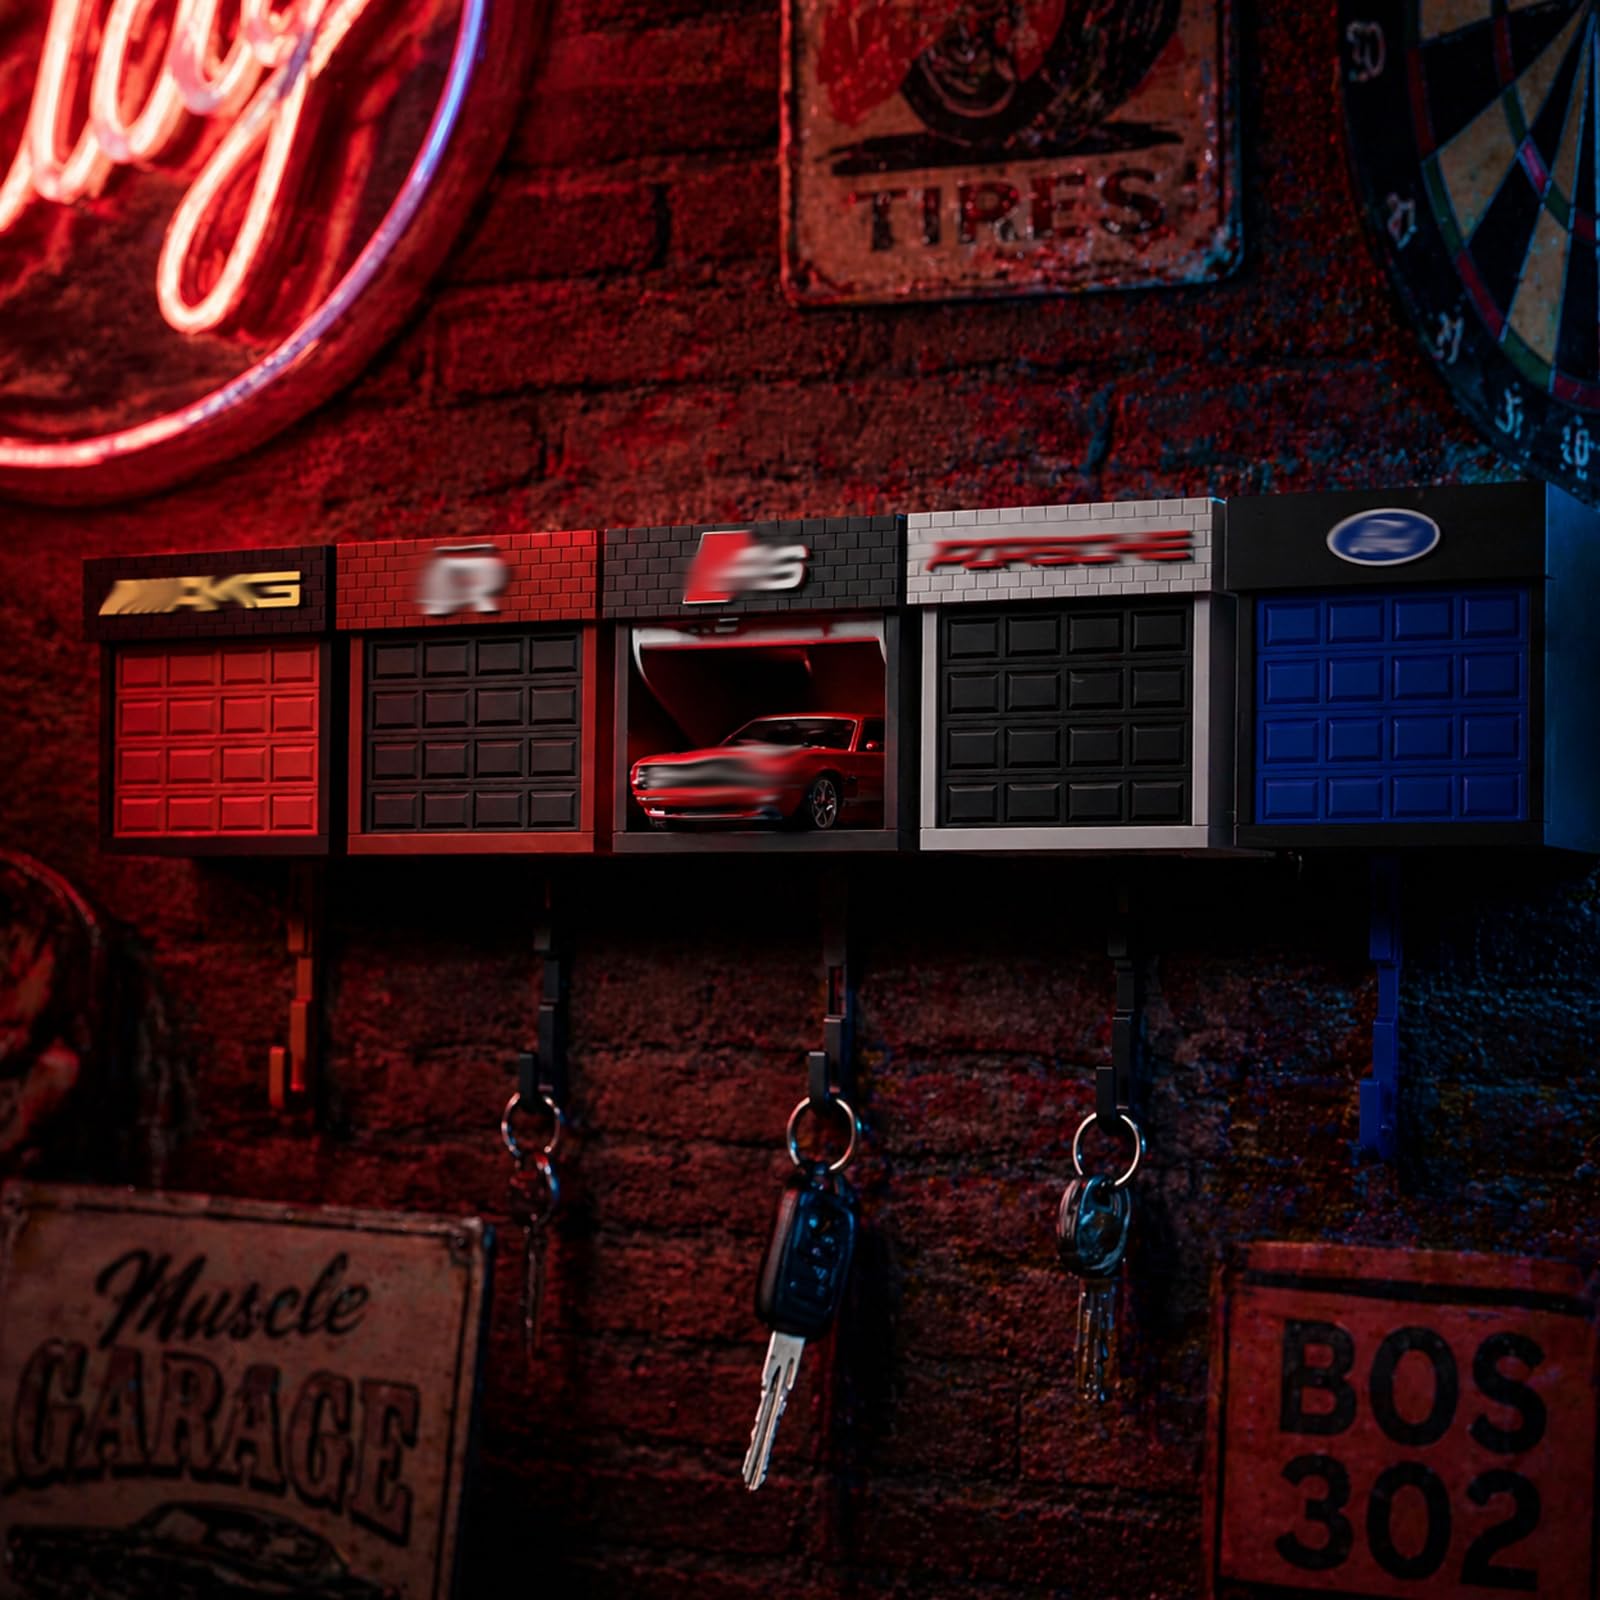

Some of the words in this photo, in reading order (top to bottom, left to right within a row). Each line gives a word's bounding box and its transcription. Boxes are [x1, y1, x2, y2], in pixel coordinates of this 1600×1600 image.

[846, 167, 1167, 252] TIRES
[96, 1250, 370, 1349] Muscle
[12, 1337, 421, 1546] GARAGE
[1279, 1318, 1547, 1454] BOS
[1274, 1453, 1541, 1591] 302
